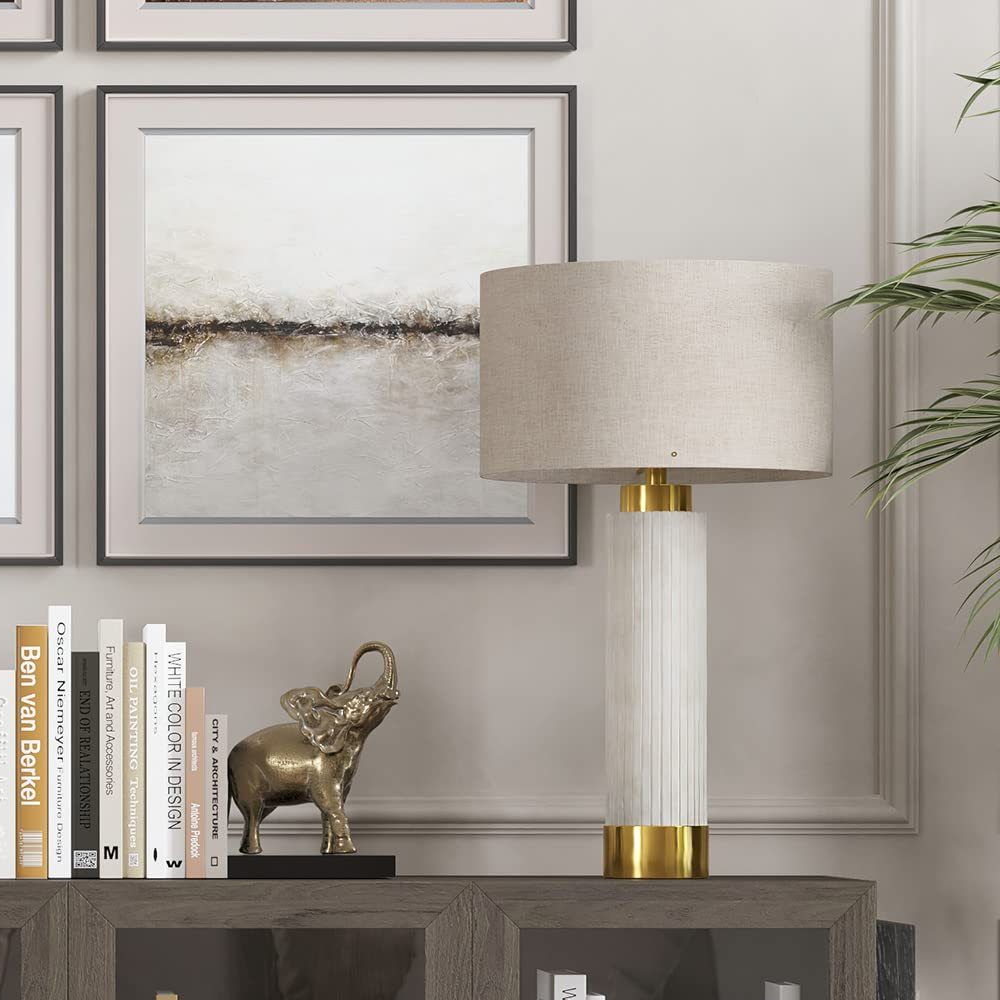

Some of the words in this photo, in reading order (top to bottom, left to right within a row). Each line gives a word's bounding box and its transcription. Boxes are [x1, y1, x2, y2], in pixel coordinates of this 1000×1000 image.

[21, 645, 41, 687] Ben
[56, 621, 65, 673] Oscar
[105, 645, 115, 694] Furniture,
[129, 666, 138, 694] OIL
[168, 652, 181, 699] WHITE
[21, 692, 37, 733] van
[55, 679, 65, 763] Niemeyer
[80, 690, 90, 717] END
[80, 718, 90, 734] OF
[106, 695, 115, 711] Art
[106, 711, 115, 730] and
[129, 696, 138, 771] PAINTING
[168, 702, 181, 753] COLOR
[212, 745, 218, 754] &
[21, 739, 41, 807] Berkel
[80, 736, 91, 830] REALATIONSHIP
[106, 733, 115, 796] Accessories
[168, 757, 181, 772] IN
[129, 776, 138, 848] Techniques
[168, 775, 181, 831] DESIGN
[55, 822, 63, 864] Design
